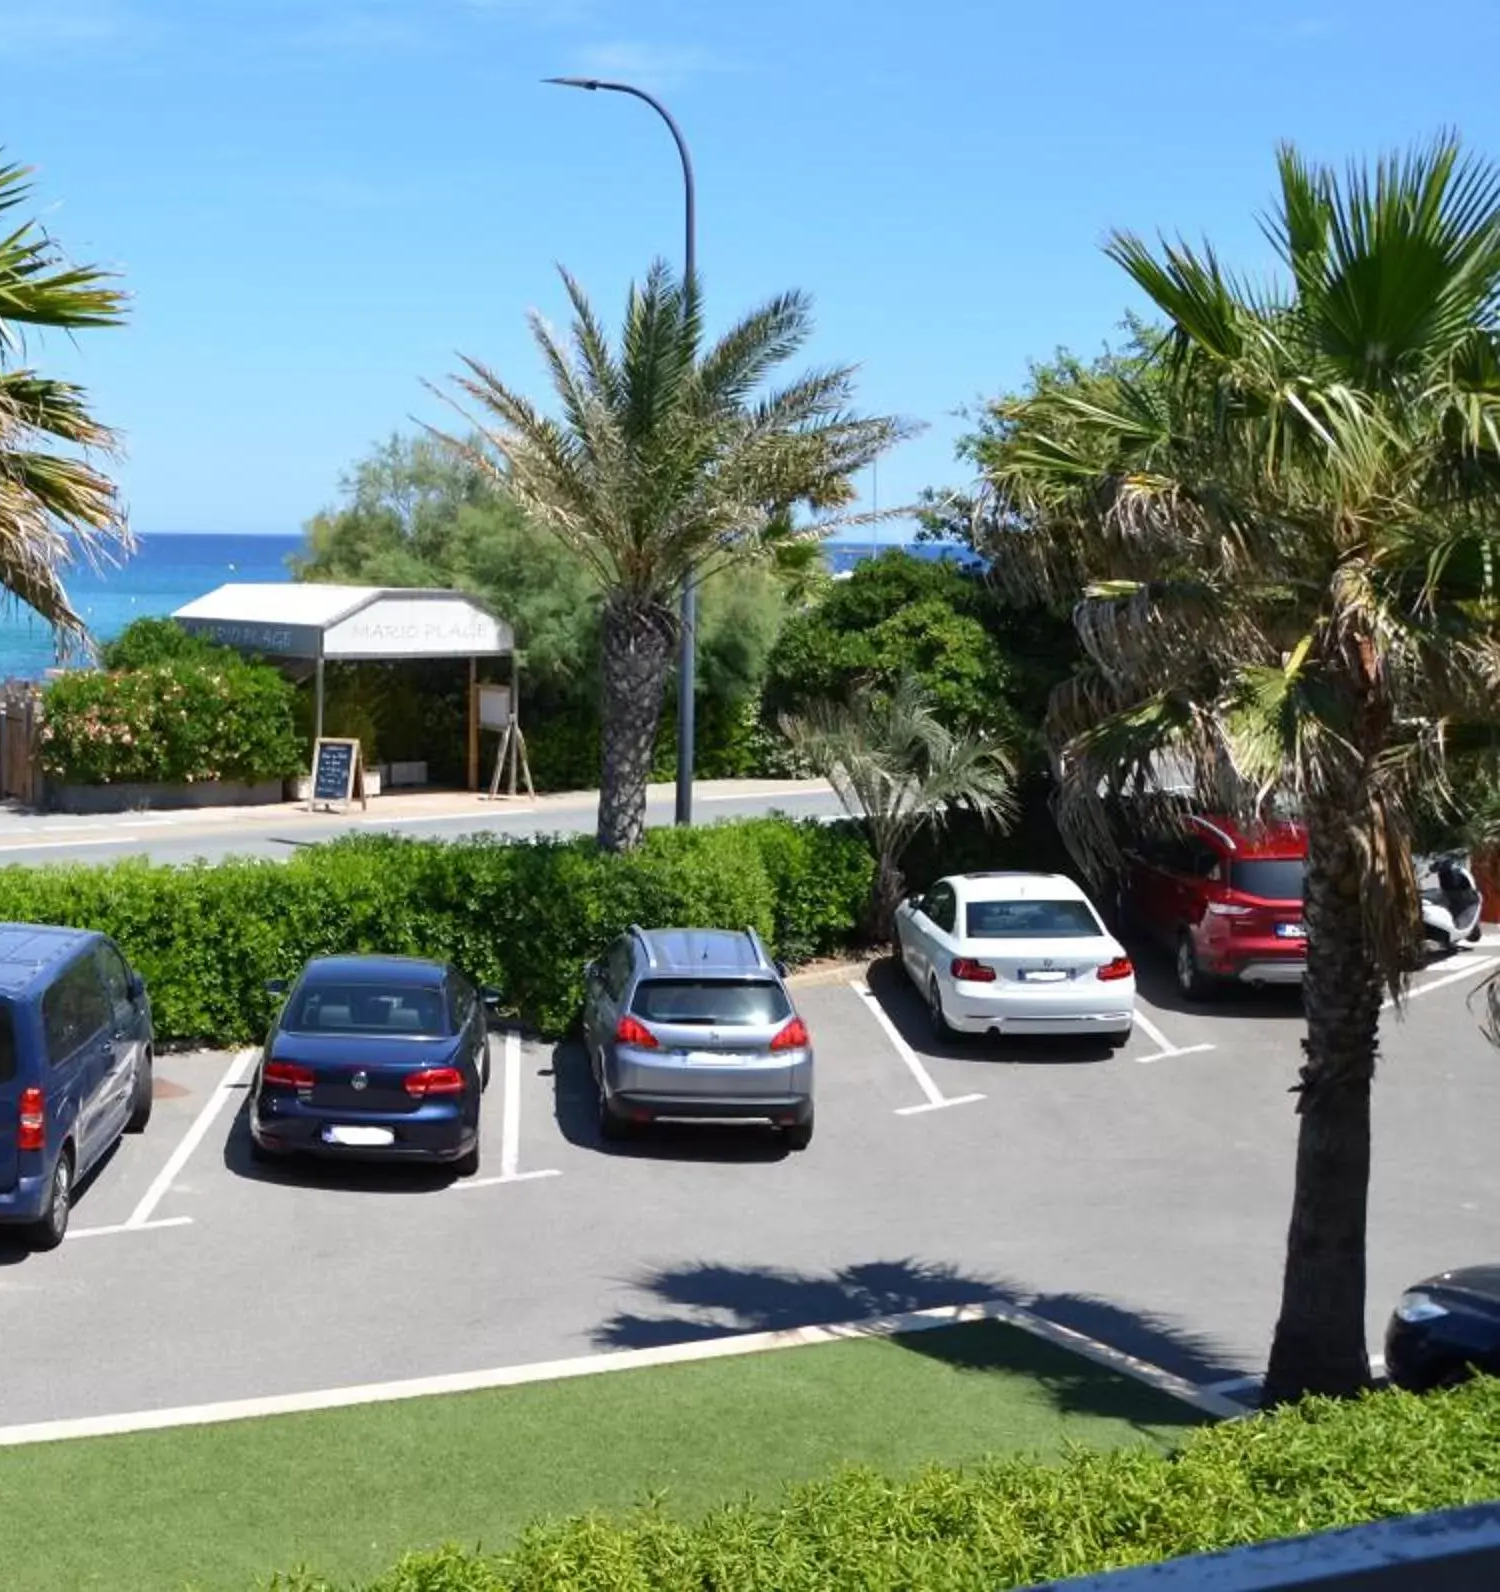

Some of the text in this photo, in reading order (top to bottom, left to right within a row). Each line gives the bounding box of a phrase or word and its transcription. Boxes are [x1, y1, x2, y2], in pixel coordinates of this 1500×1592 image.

[243, 627, 292, 648] PLAGE
[350, 622, 487, 640] MARIO PLAGE
